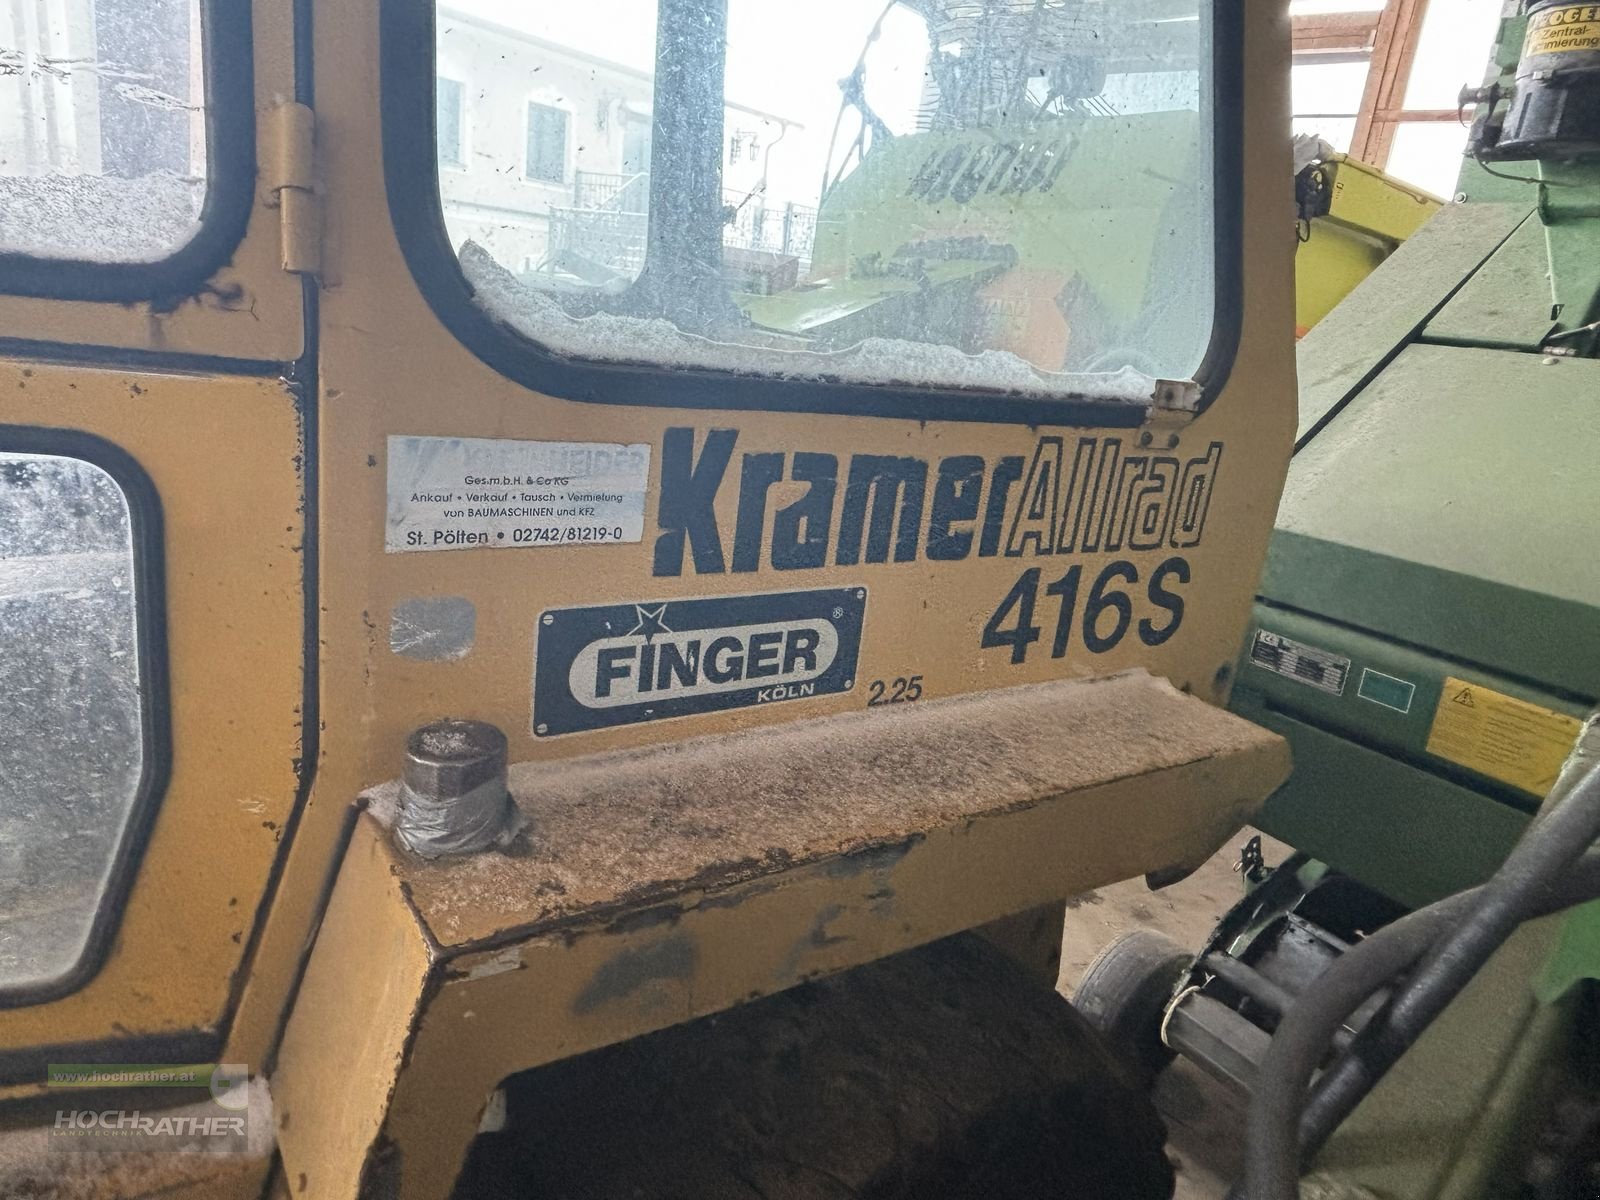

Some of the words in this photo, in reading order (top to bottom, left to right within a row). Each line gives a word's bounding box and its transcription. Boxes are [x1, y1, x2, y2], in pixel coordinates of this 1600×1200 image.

[410, 493, 453, 503] Ankauf
[466, 493, 508, 502] Verkauf
[520, 493, 556, 502] Tausch
[567, 493, 623, 504] Vermietung
[443, 510, 465, 518] von
[467, 507, 554, 518] BAUMASCHINEN
[556, 507, 576, 517] und
[578, 507, 595, 516] KFZ
[406, 530, 428, 546] St.
[433, 529, 489, 545] Pölten
[512, 526, 623, 543] 02742/81219-0
[981, 556, 1191, 665] 416S
[595, 629, 820, 699] FINGER
[756, 683, 815, 704] KÖLN
[867, 676, 924, 707] 2.25
